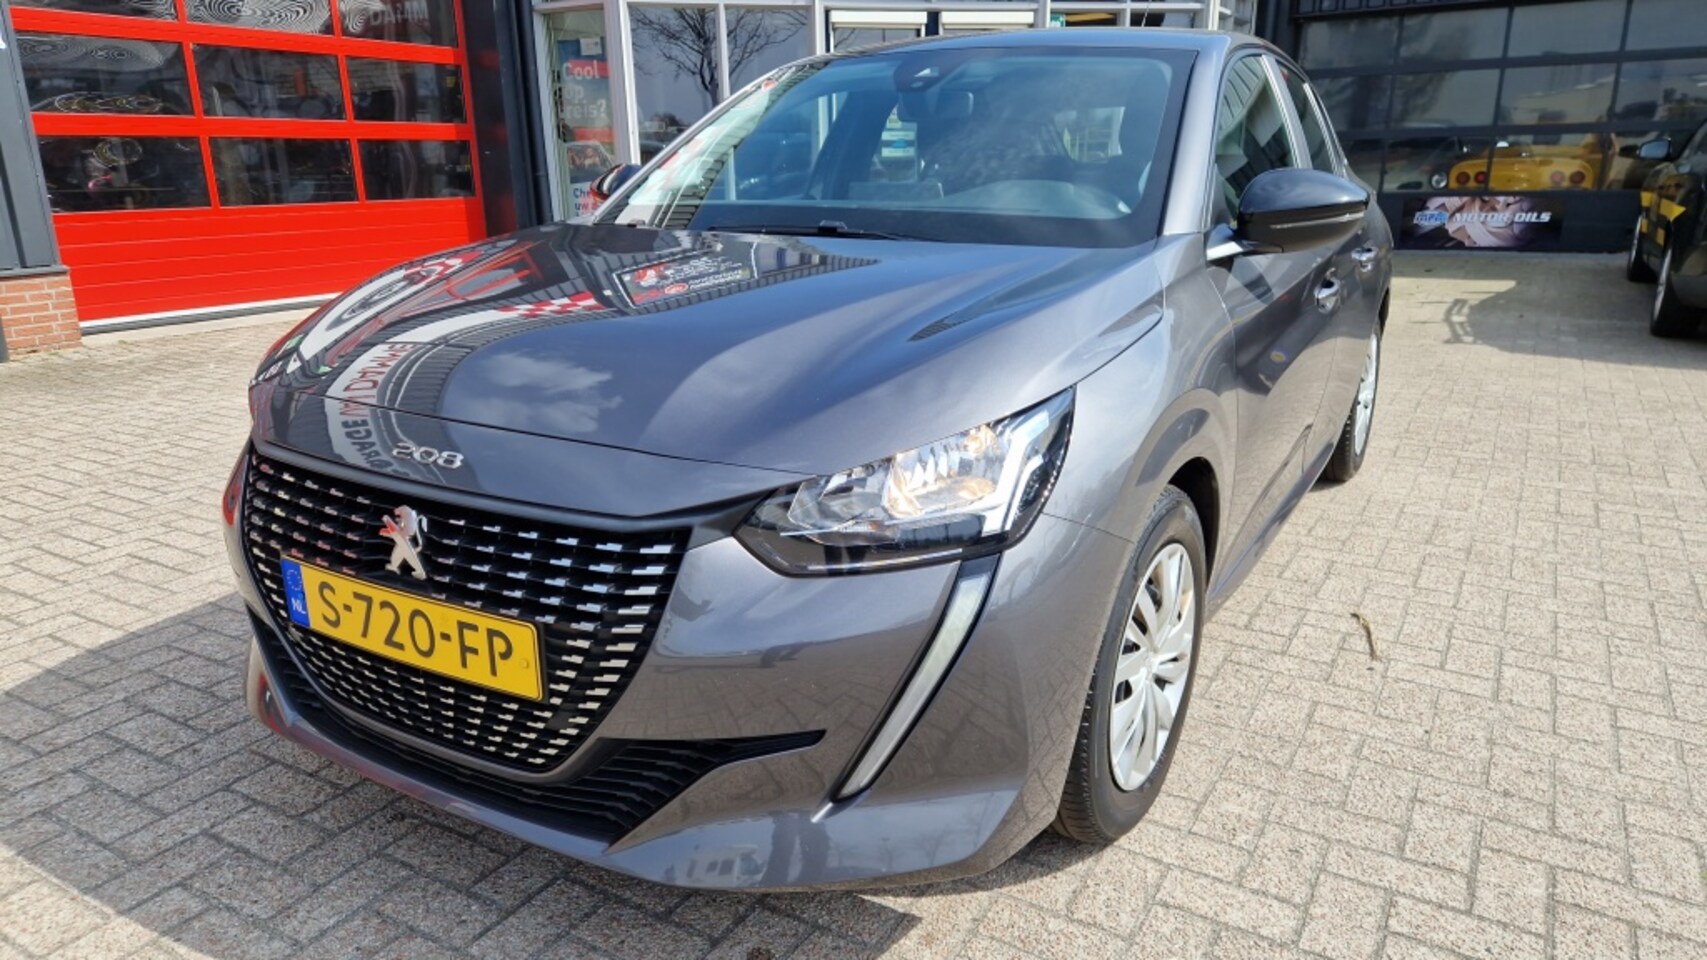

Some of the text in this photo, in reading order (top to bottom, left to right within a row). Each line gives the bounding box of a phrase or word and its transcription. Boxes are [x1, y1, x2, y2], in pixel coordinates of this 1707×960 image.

[562, 60, 600, 80] Cool
[1453, 211, 1510, 223] MOTOR
[1514, 211, 1552, 223] OILS
[392, 442, 464, 469] 208
[292, 598, 306, 615] NL
[318, 581, 513, 677] S-720-FP
